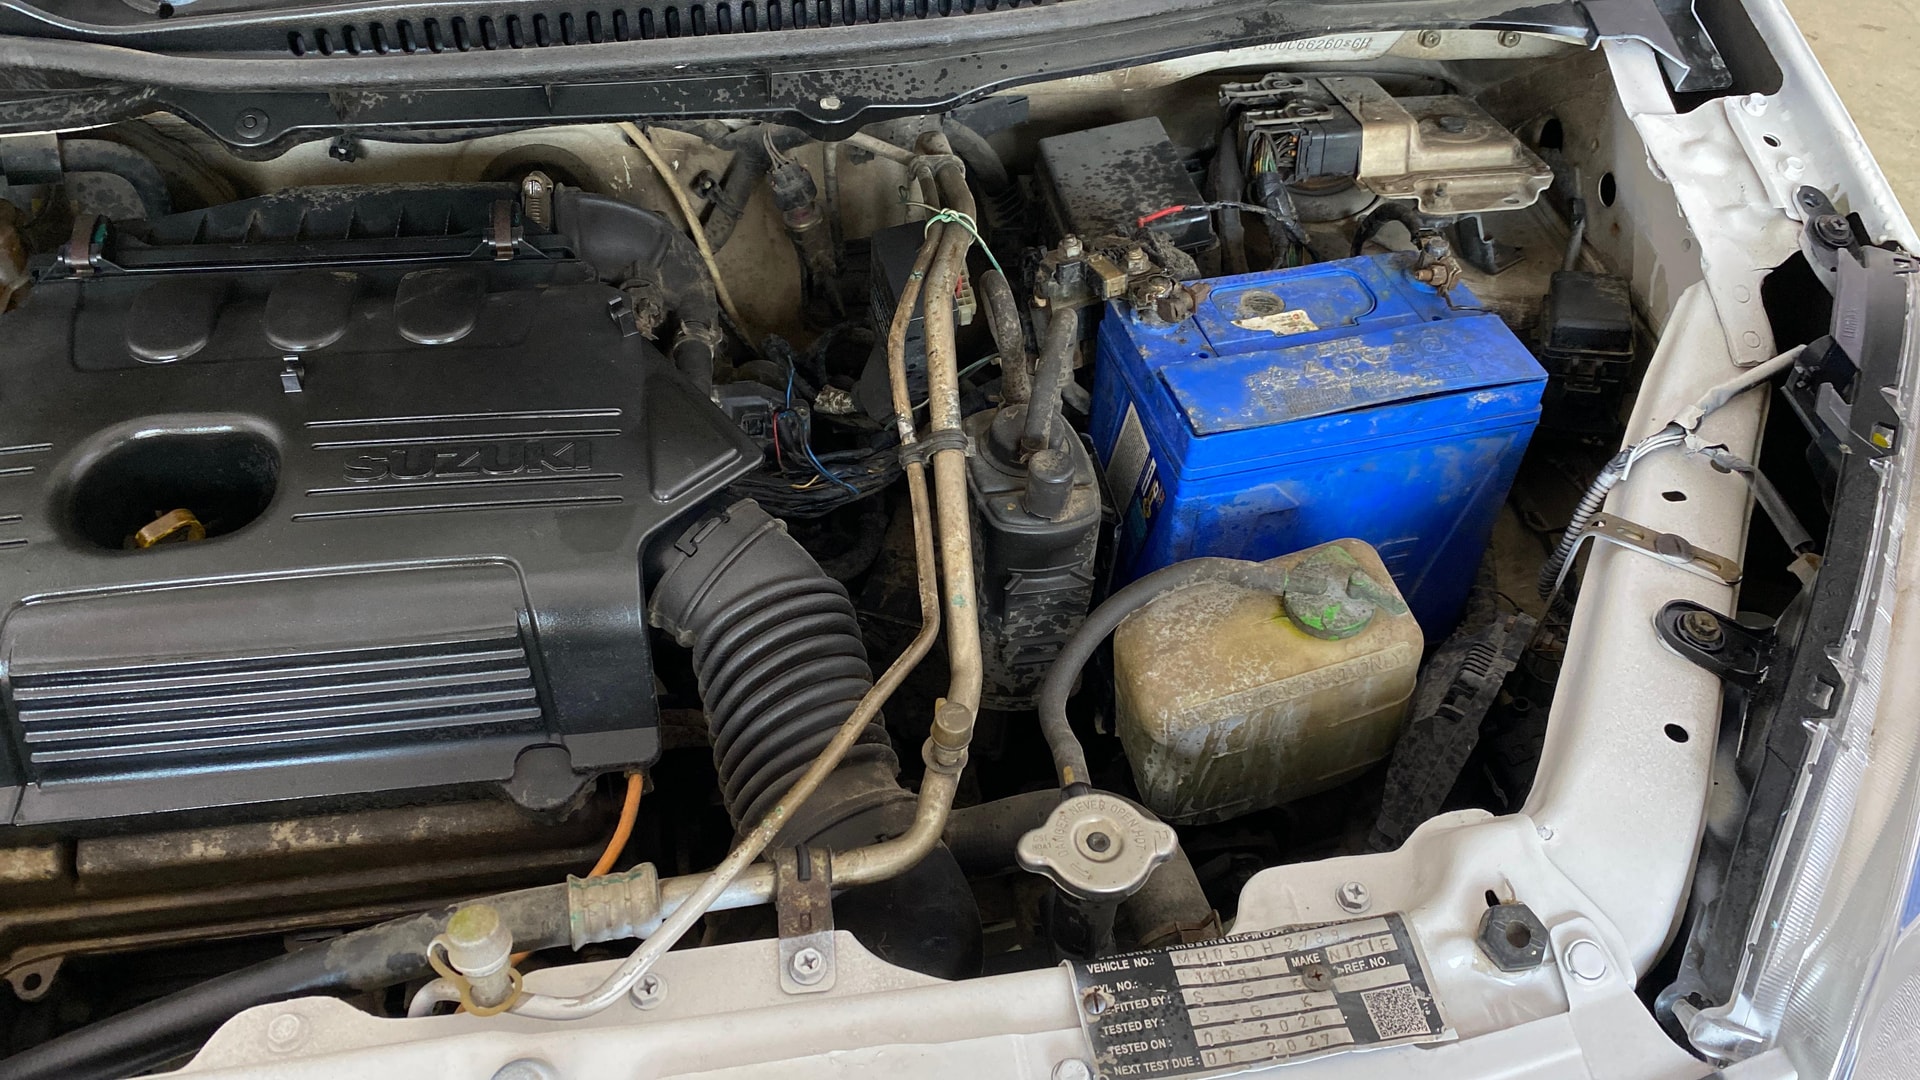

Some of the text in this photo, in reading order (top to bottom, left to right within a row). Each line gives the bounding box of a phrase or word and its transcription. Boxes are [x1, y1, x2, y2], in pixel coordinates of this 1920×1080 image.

[343, 440, 592, 482] SUZUKI
[1069, 800, 1106, 815] NEVER
[1110, 803, 1138, 827] OPEN
[1086, 960, 1130, 974] VEHICLE
[1133, 957, 1155, 968] NO.:
[1290, 953, 1321, 967] MAKE
[1343, 956, 1391, 974] REF. NO.
[1116, 980, 1139, 992] NO.:
[1151, 995, 1166, 1006] BY
[1102, 1021, 1142, 1036] TESTED
[1144, 1018, 1159, 1029] BY
[1109, 1041, 1148, 1055] TESTED
[1150, 1038, 1167, 1050] ON
[1113, 1064, 1141, 1076] NEXT
[1143, 1060, 1169, 1073] TEST
[1172, 1056, 1195, 1069] DUE
